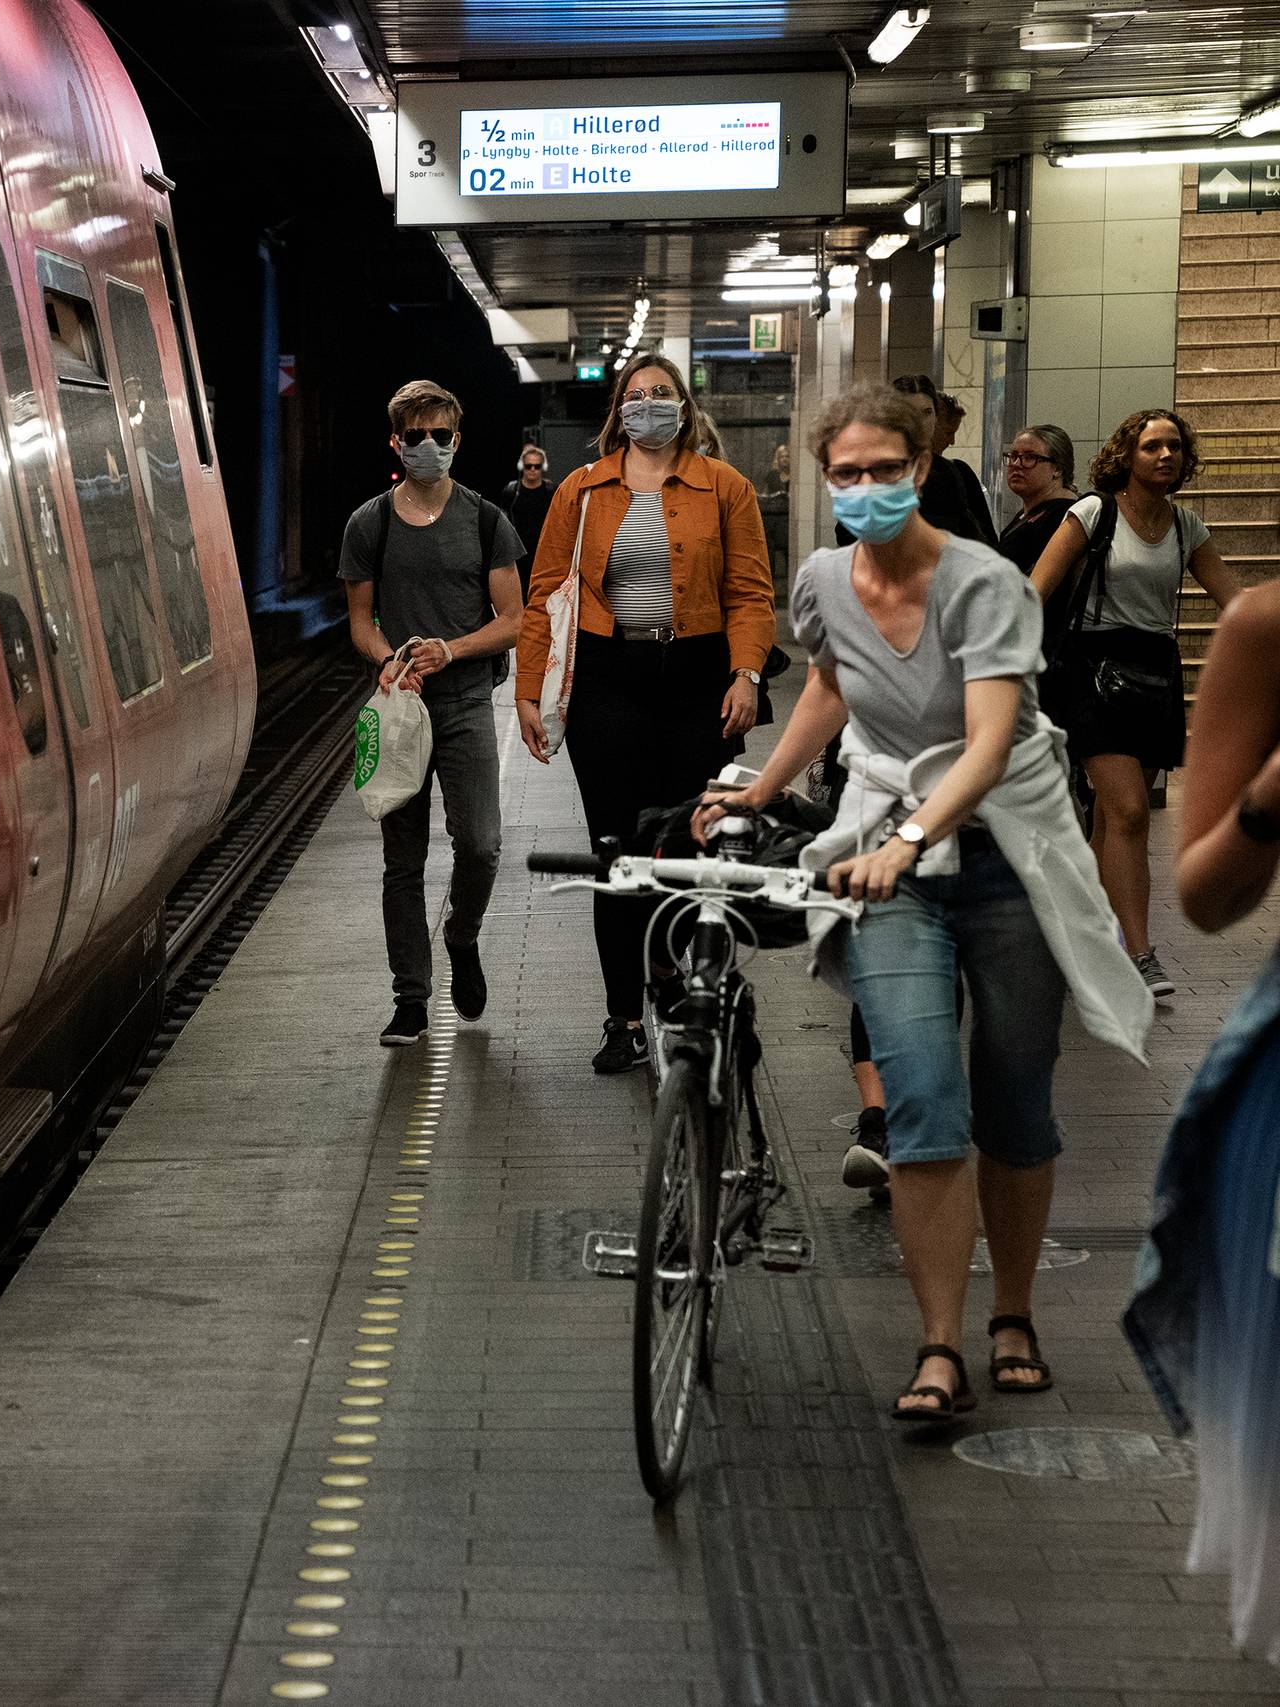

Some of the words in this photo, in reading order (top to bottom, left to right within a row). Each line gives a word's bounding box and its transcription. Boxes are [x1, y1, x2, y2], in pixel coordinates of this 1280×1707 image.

[511, 129, 535, 141] min
[573, 115, 660, 134] Hillerød
[418, 140, 437, 167] 3
[482, 146, 531, 160] Lyngby
[542, 145, 579, 156] Holte
[591, 143, 648, 155] Birkerød
[659, 141, 709, 153] Allerød
[721, 139, 775, 151] Hillerød
[409, 170, 428, 179] Spor
[428, 170, 445, 178] Track
[469, 168, 506, 192] 02
[510, 177, 535, 189] min
[549, 166, 563, 186] E
[572, 166, 631, 184] Holte
